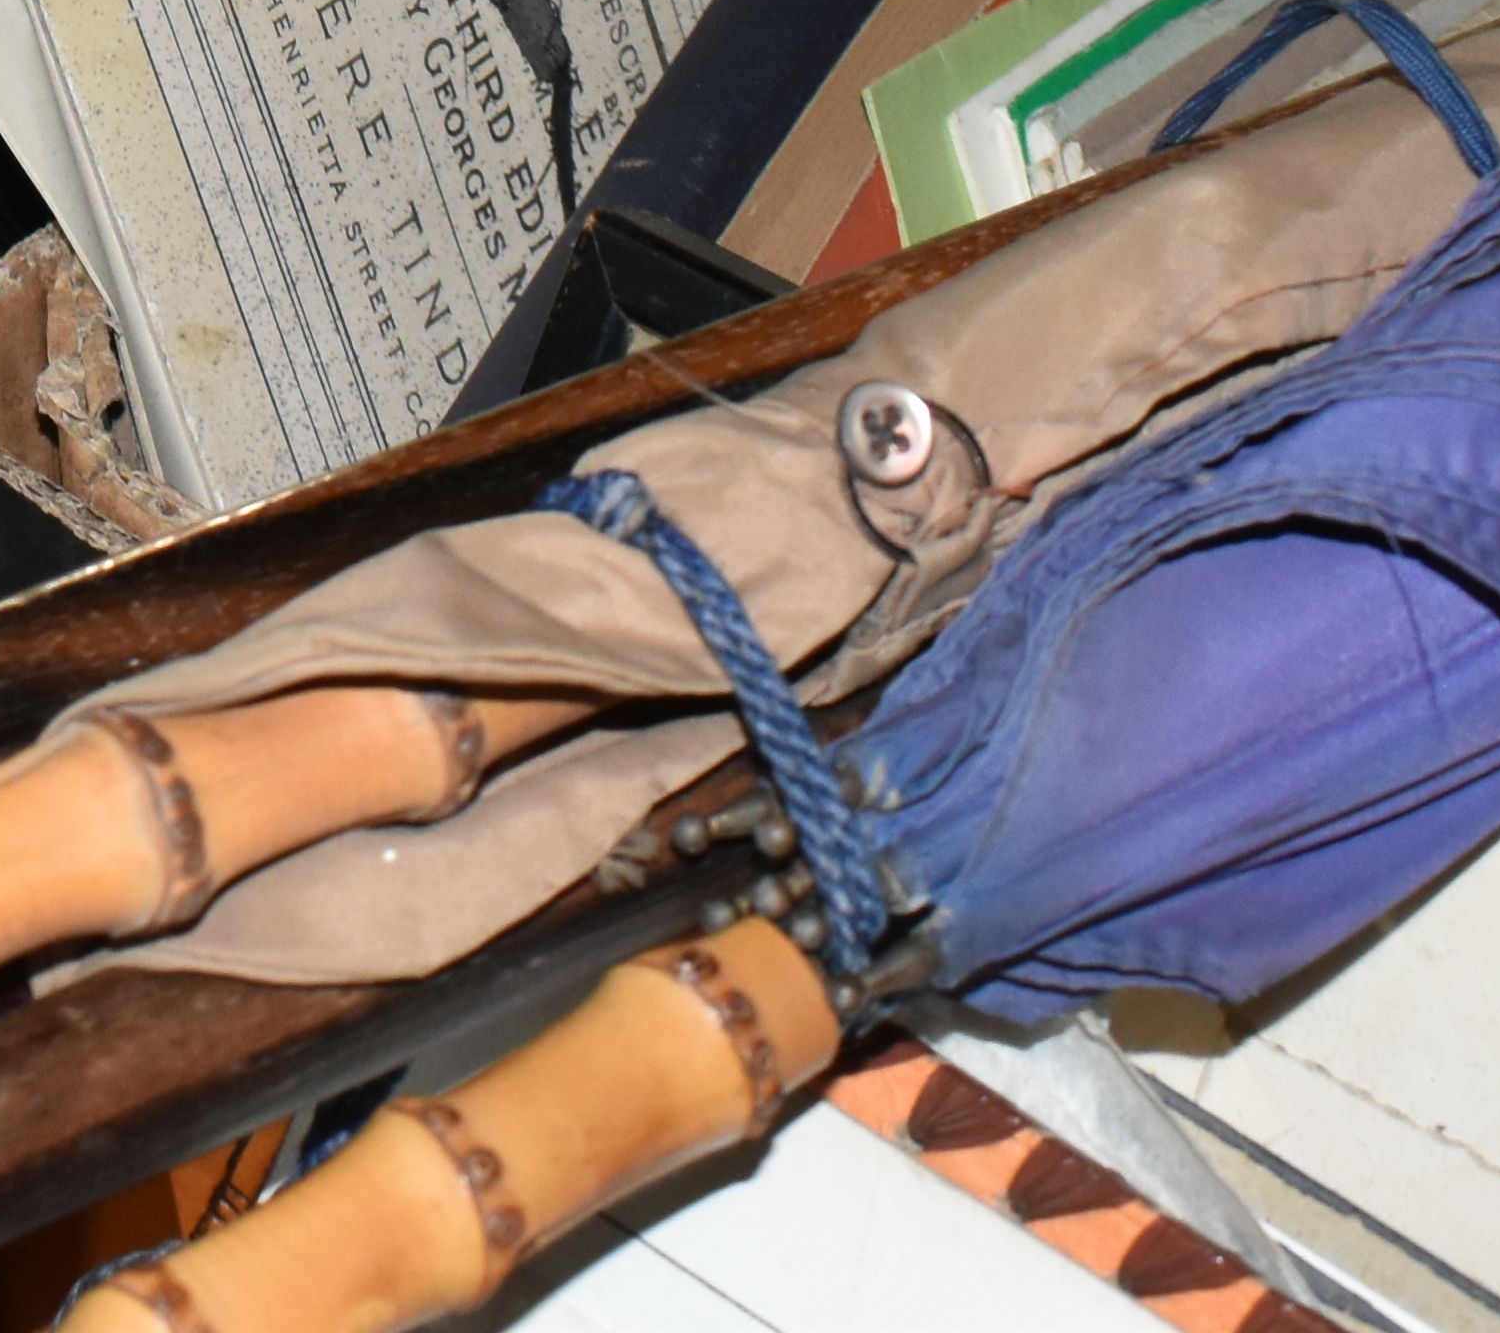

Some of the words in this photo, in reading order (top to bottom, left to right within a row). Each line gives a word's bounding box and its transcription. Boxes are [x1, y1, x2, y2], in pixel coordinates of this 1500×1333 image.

[423, 36, 507, 261] GEORGES
[603, 91, 627, 129] BY
[343, 219, 406, 361] STREET
